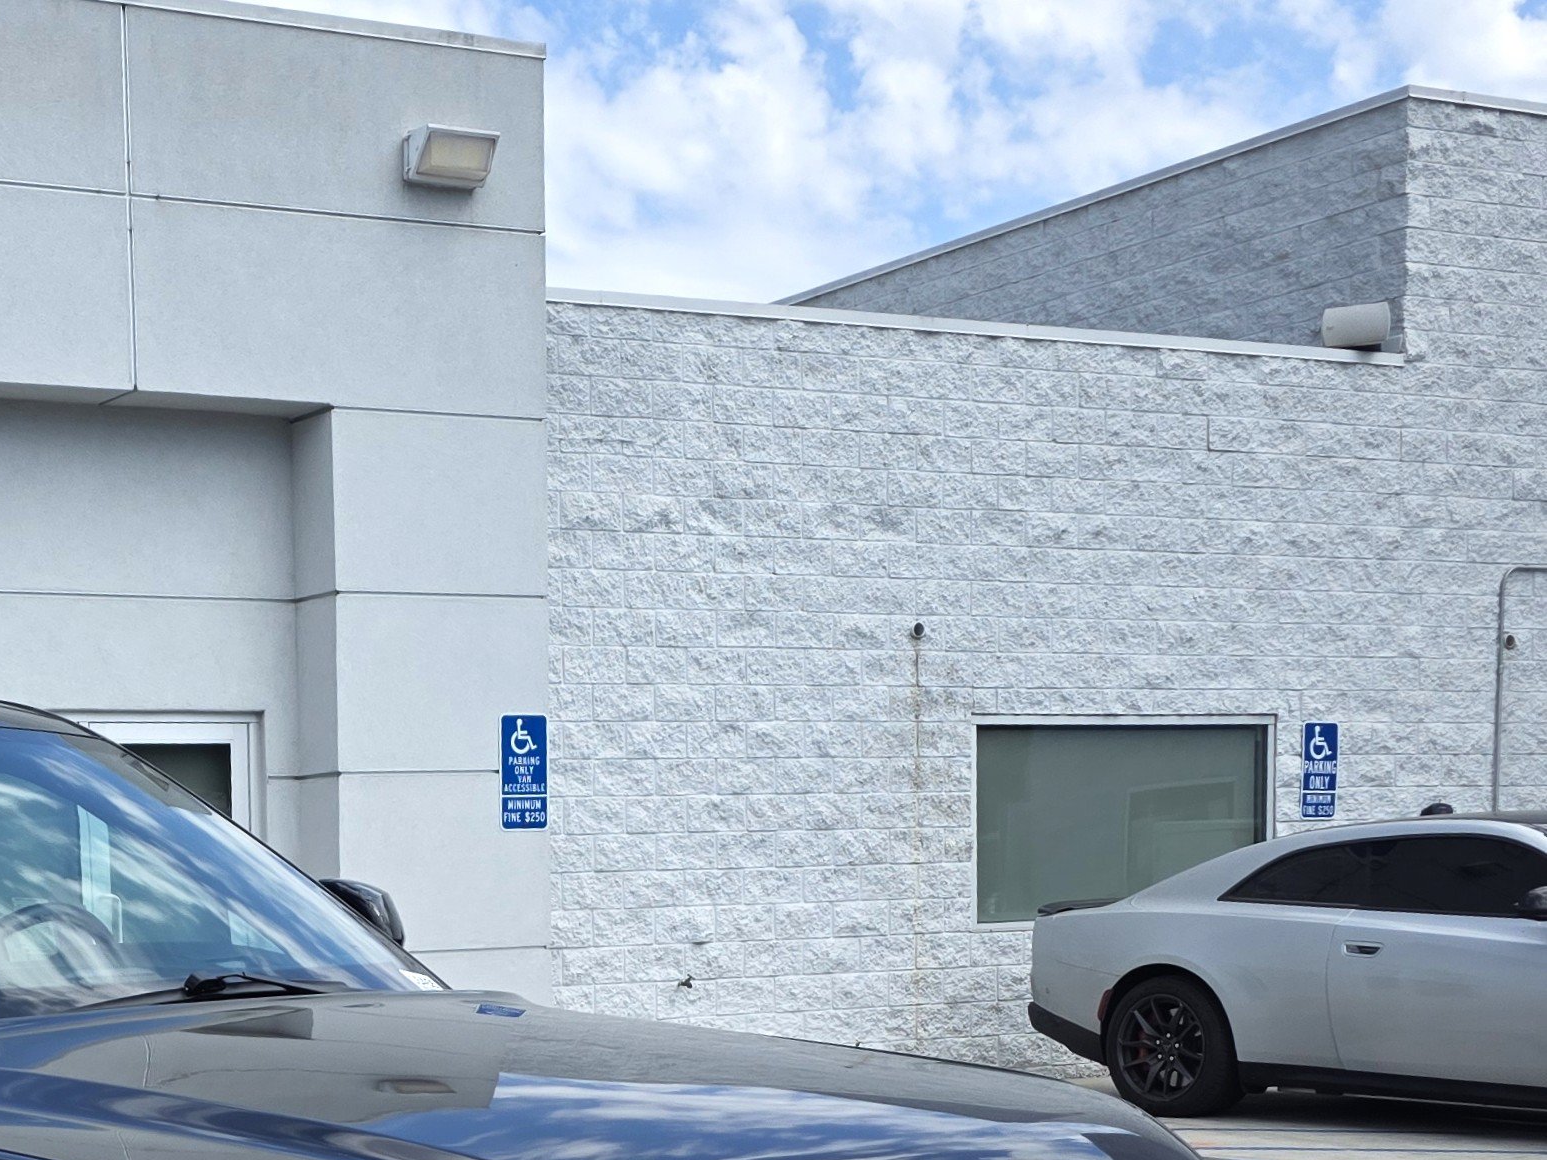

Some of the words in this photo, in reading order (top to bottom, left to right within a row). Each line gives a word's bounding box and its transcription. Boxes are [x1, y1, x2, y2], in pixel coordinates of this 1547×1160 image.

[508, 756, 541, 766] PARKING
[514, 766, 534, 775] ONLY
[1303, 760, 1337, 774] PARKING
[517, 775, 532, 783] VAN
[1309, 775, 1330, 789] ONLY
[504, 783, 546, 792] ACCESSIBLE
[1306, 794, 1331, 804] MINIMUM
[507, 799, 542, 810] MINIMUM
[1302, 804, 1316, 816] FINE
[1317, 804, 1334, 816] $250
[503, 812, 522, 823] FINE
[524, 811, 546, 823] $250
